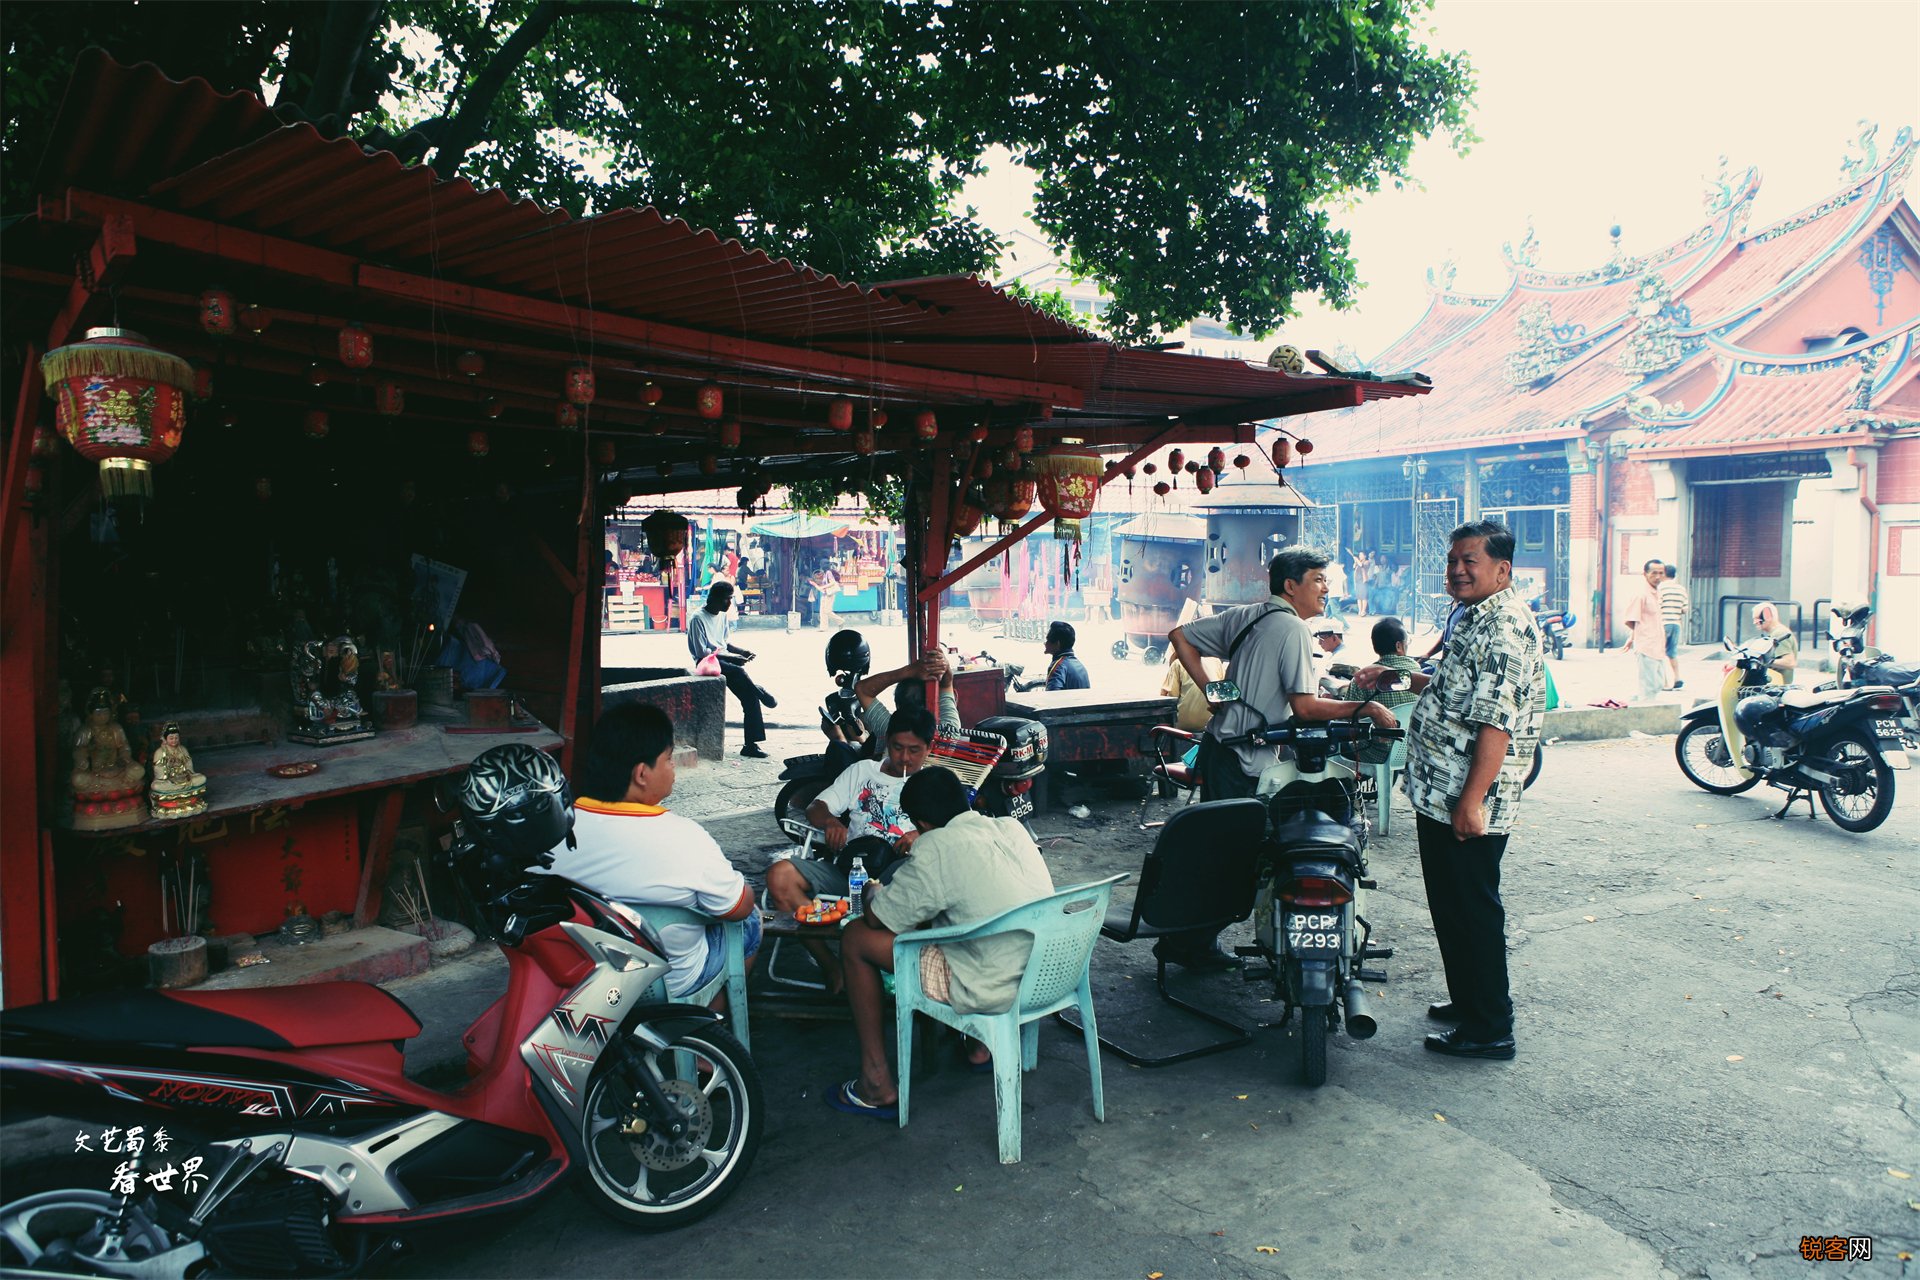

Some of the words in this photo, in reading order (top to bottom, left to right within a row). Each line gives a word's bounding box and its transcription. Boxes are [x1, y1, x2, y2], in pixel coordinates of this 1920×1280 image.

[1875, 728, 1904, 737] 5625
[1012, 793, 1025, 807] PX
[1289, 933, 1339, 949] 7293
